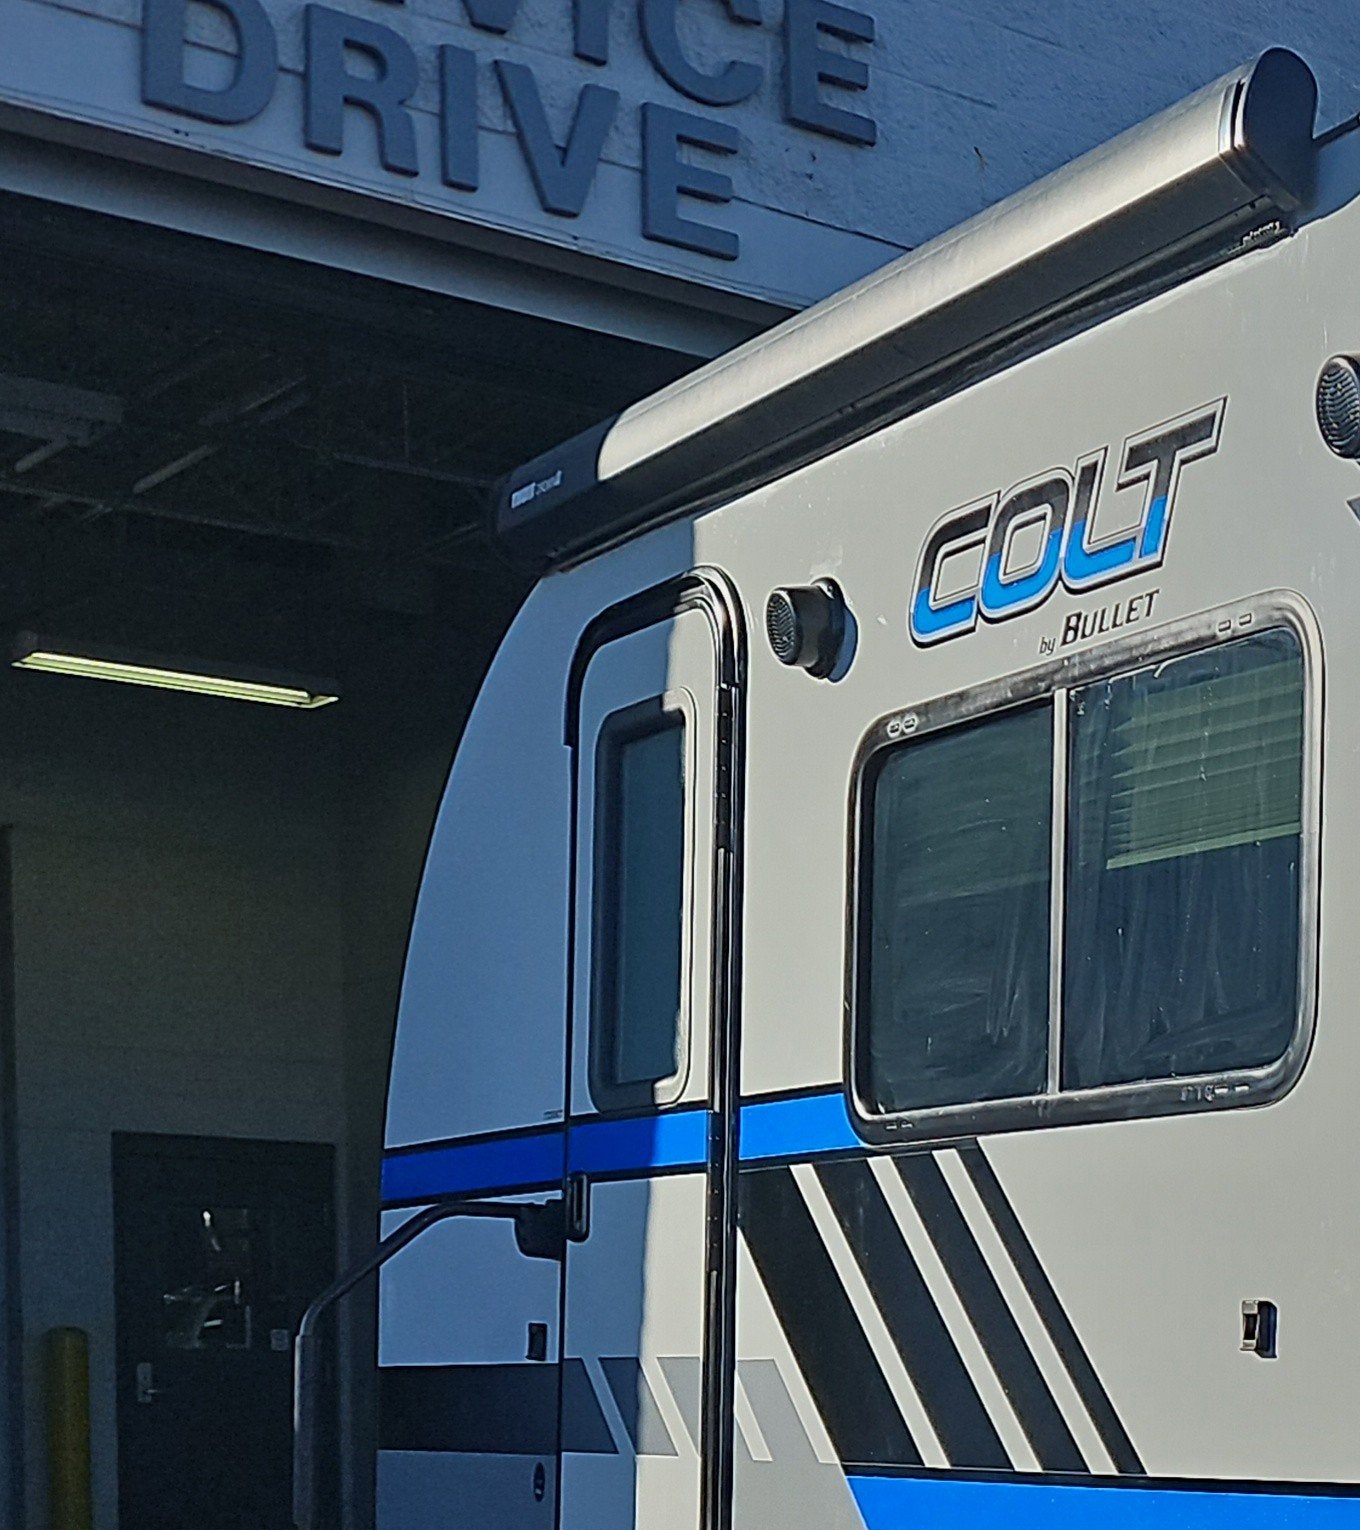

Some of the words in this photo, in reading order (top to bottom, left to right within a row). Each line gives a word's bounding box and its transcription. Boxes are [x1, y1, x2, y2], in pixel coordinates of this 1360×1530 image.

[140, 0, 739, 261] DRIVE
[909, 395, 1229, 650] COLT
[1039, 636, 1055, 655] by
[1060, 589, 1160, 648] BULLET
